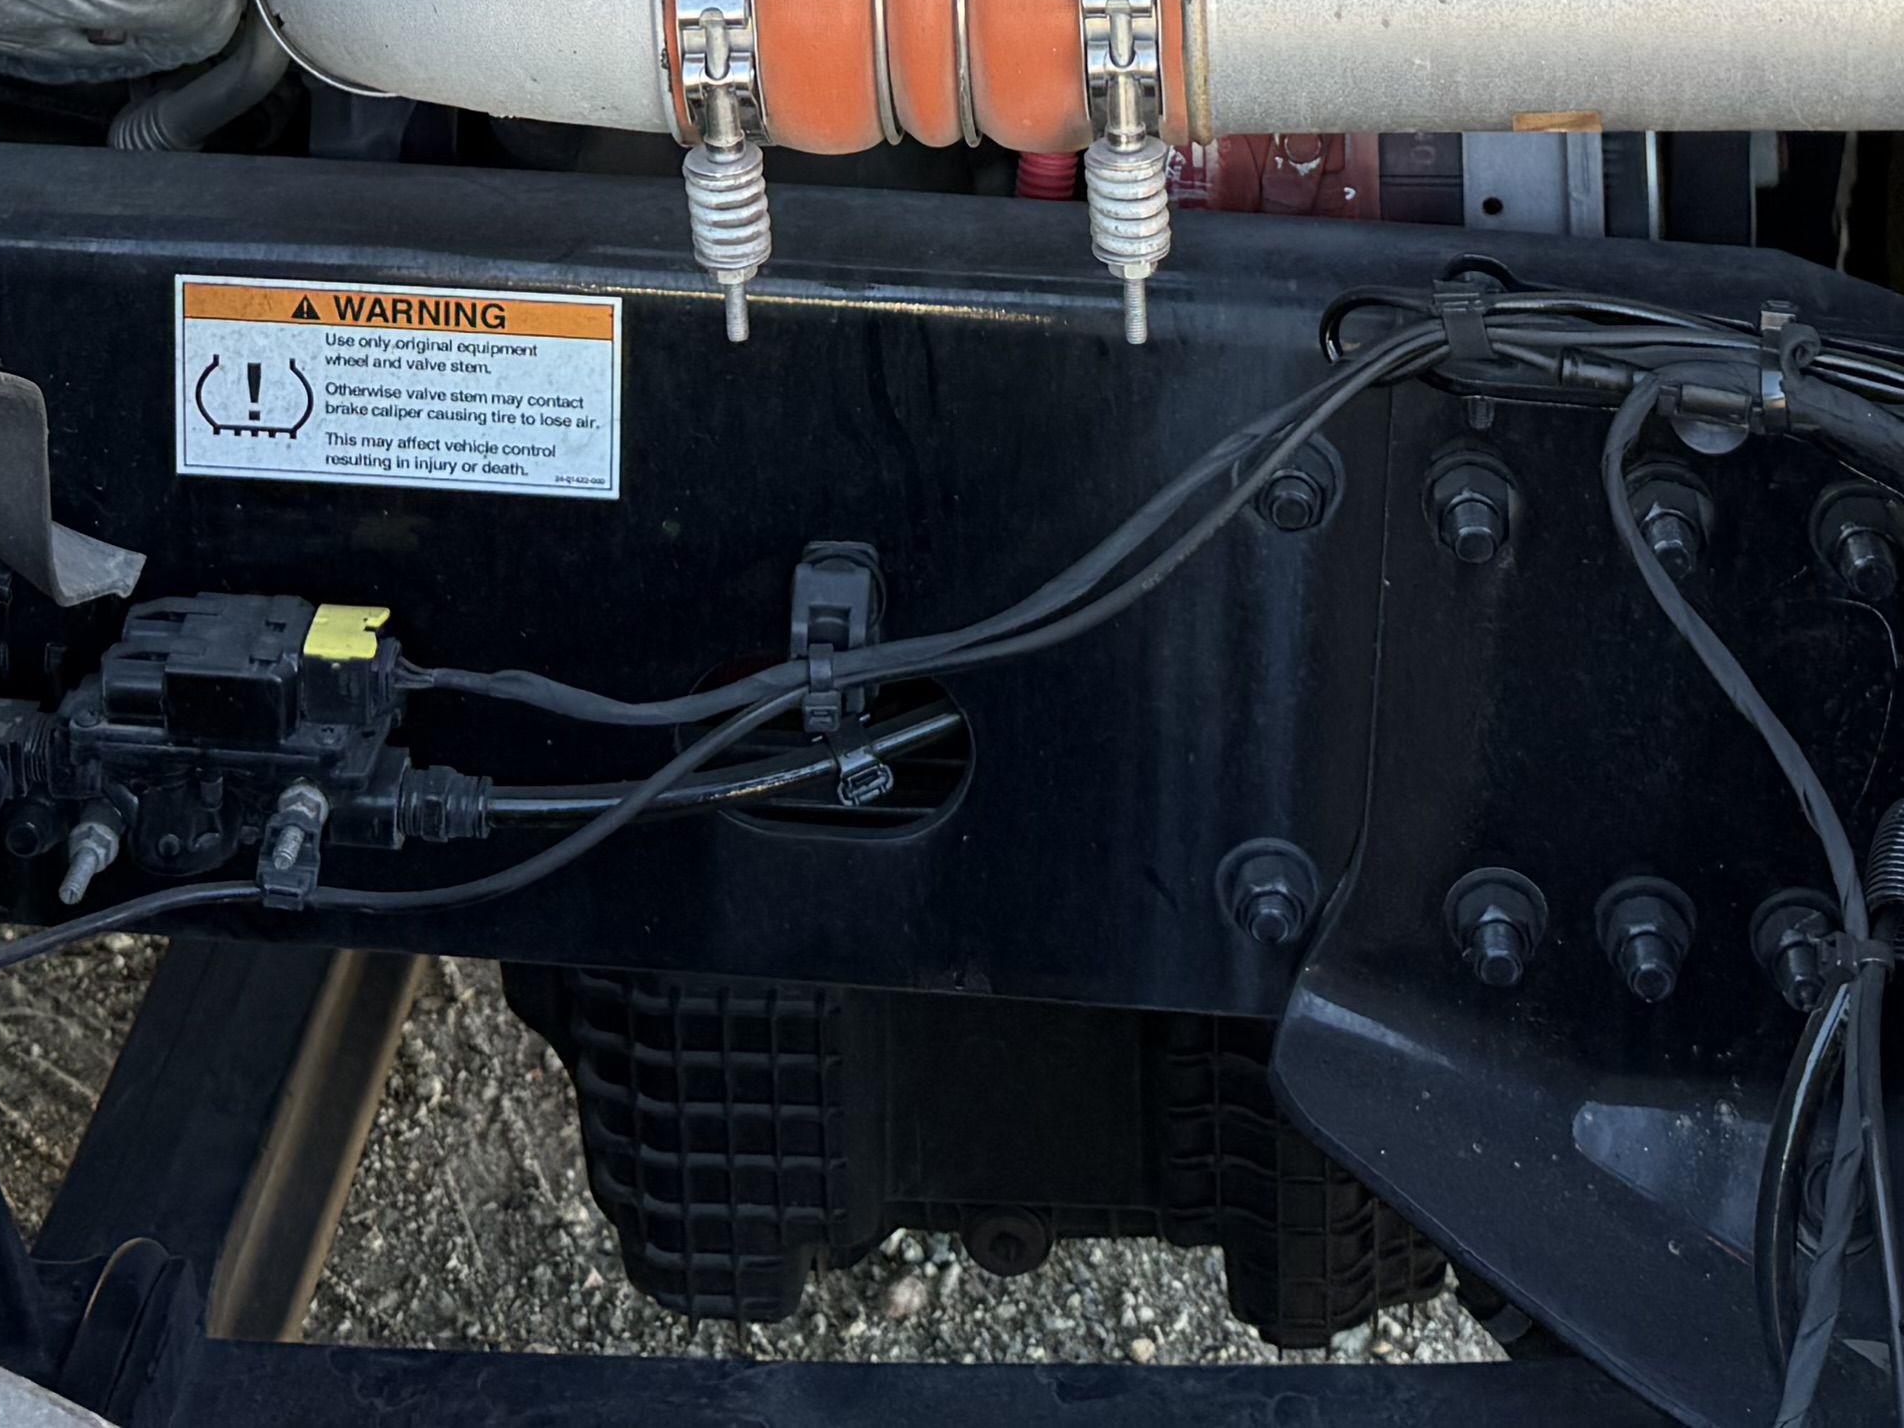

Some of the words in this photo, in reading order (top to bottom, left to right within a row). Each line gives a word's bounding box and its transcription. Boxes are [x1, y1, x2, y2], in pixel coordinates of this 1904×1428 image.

[334, 295, 507, 330] WARNING
[325, 332, 355, 347] Use
[359, 334, 391, 352] only
[396, 336, 452, 355] original
[457, 342, 538, 358] equipment
[325, 354, 368, 368] wheel
[373, 356, 401, 370] and
[406, 357, 446, 372] valve
[450, 361, 491, 374] stem.
[325, 381, 402, 399] Otherwise
[406, 387, 447, 402] valve
[450, 390, 488, 405] stem
[491, 394, 523, 409] may
[527, 395, 584, 409] contact
[325, 401, 369, 416] brake
[371, 403, 423, 421] caliper
[427, 408, 487, 425] causing
[491, 411, 517, 425] tire
[521, 412, 536, 426] to
[540, 413, 572, 428] lose
[576, 416, 600, 430] air.
[325, 432, 357, 447] This
[361, 435, 393, 451] may
[397, 436, 440, 451] affect
[444, 439, 498, 455] vehicle
[502, 443, 556, 458] control
[325, 454, 392, 472] resulting
[396, 455, 410, 470] in
[414, 457, 457, 475] injury
[461, 461, 477, 474] or
[482, 461, 529, 476] death.
